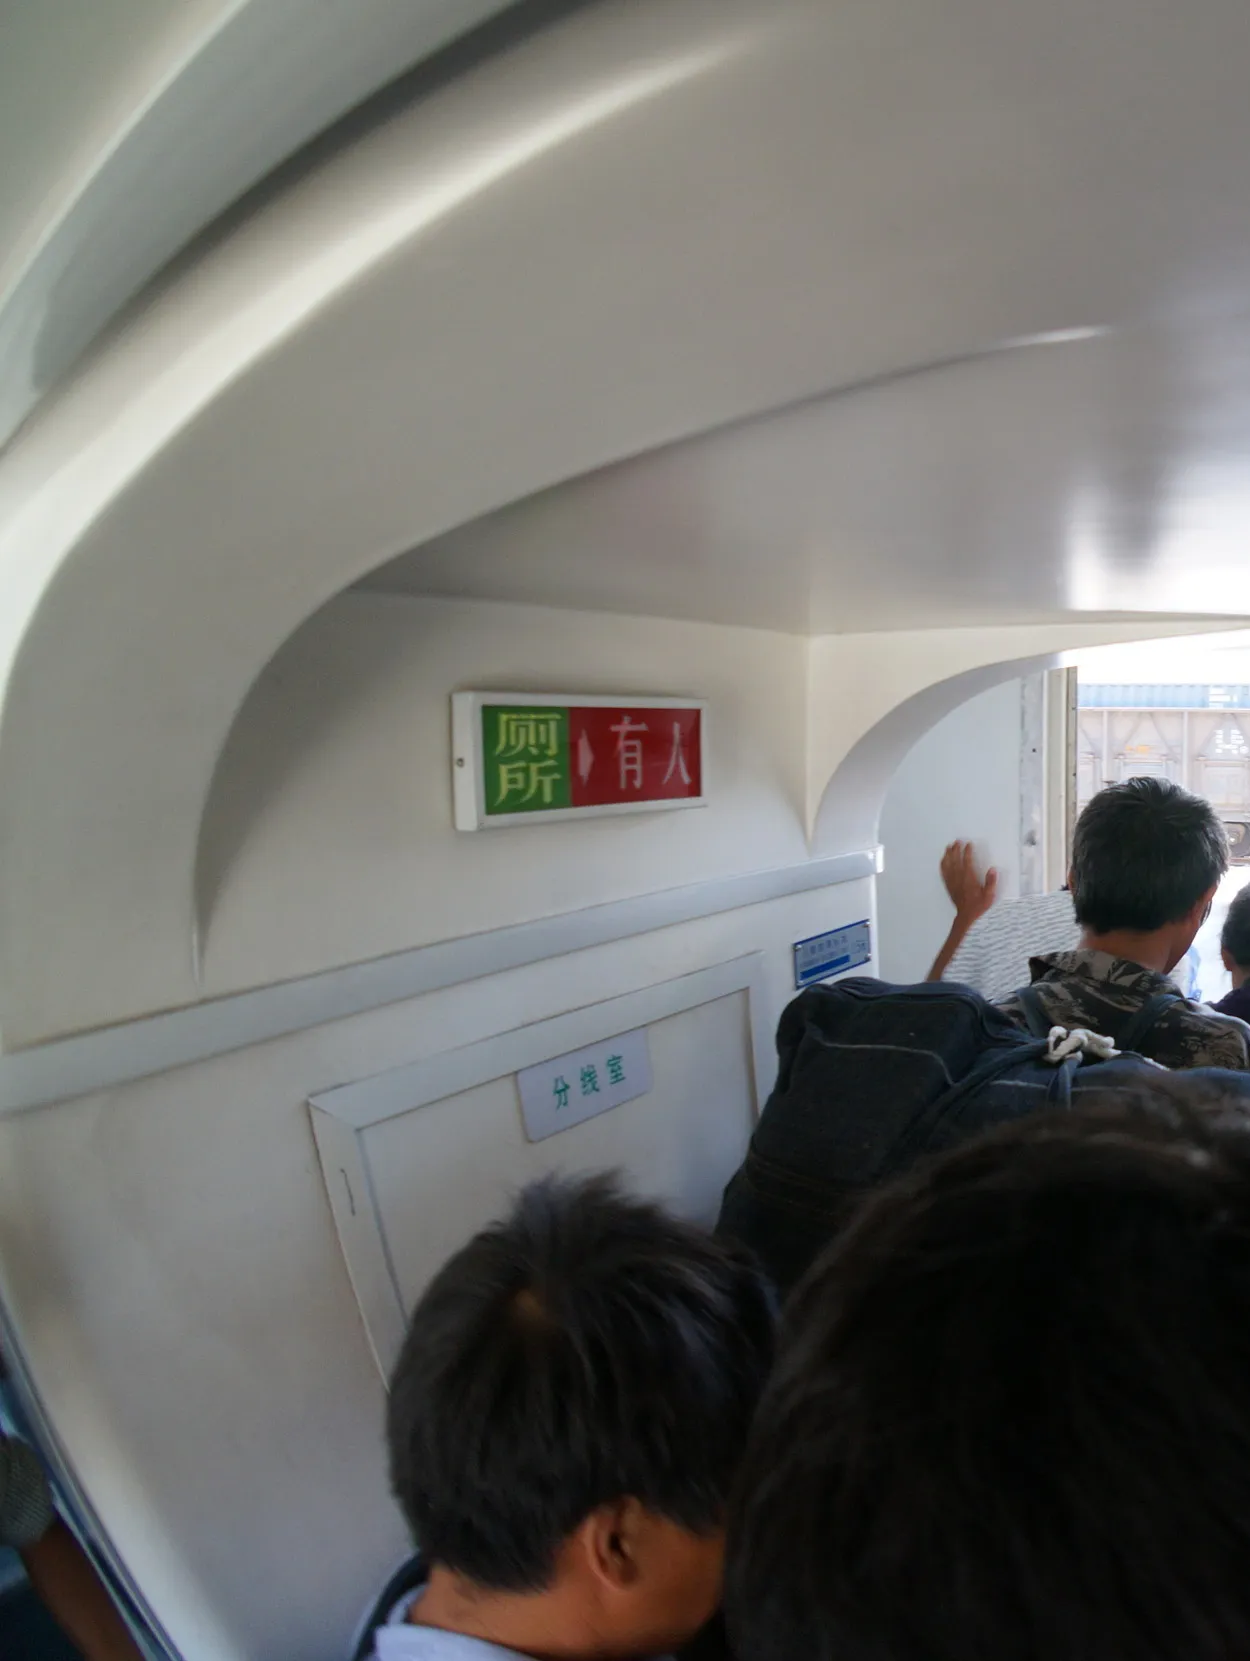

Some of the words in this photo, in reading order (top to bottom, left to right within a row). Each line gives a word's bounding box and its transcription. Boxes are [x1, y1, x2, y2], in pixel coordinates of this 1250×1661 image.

[494, 712, 561, 806] 厕所
[610, 716, 692, 790] 有人
[553, 1055, 626, 1110] 分线室
